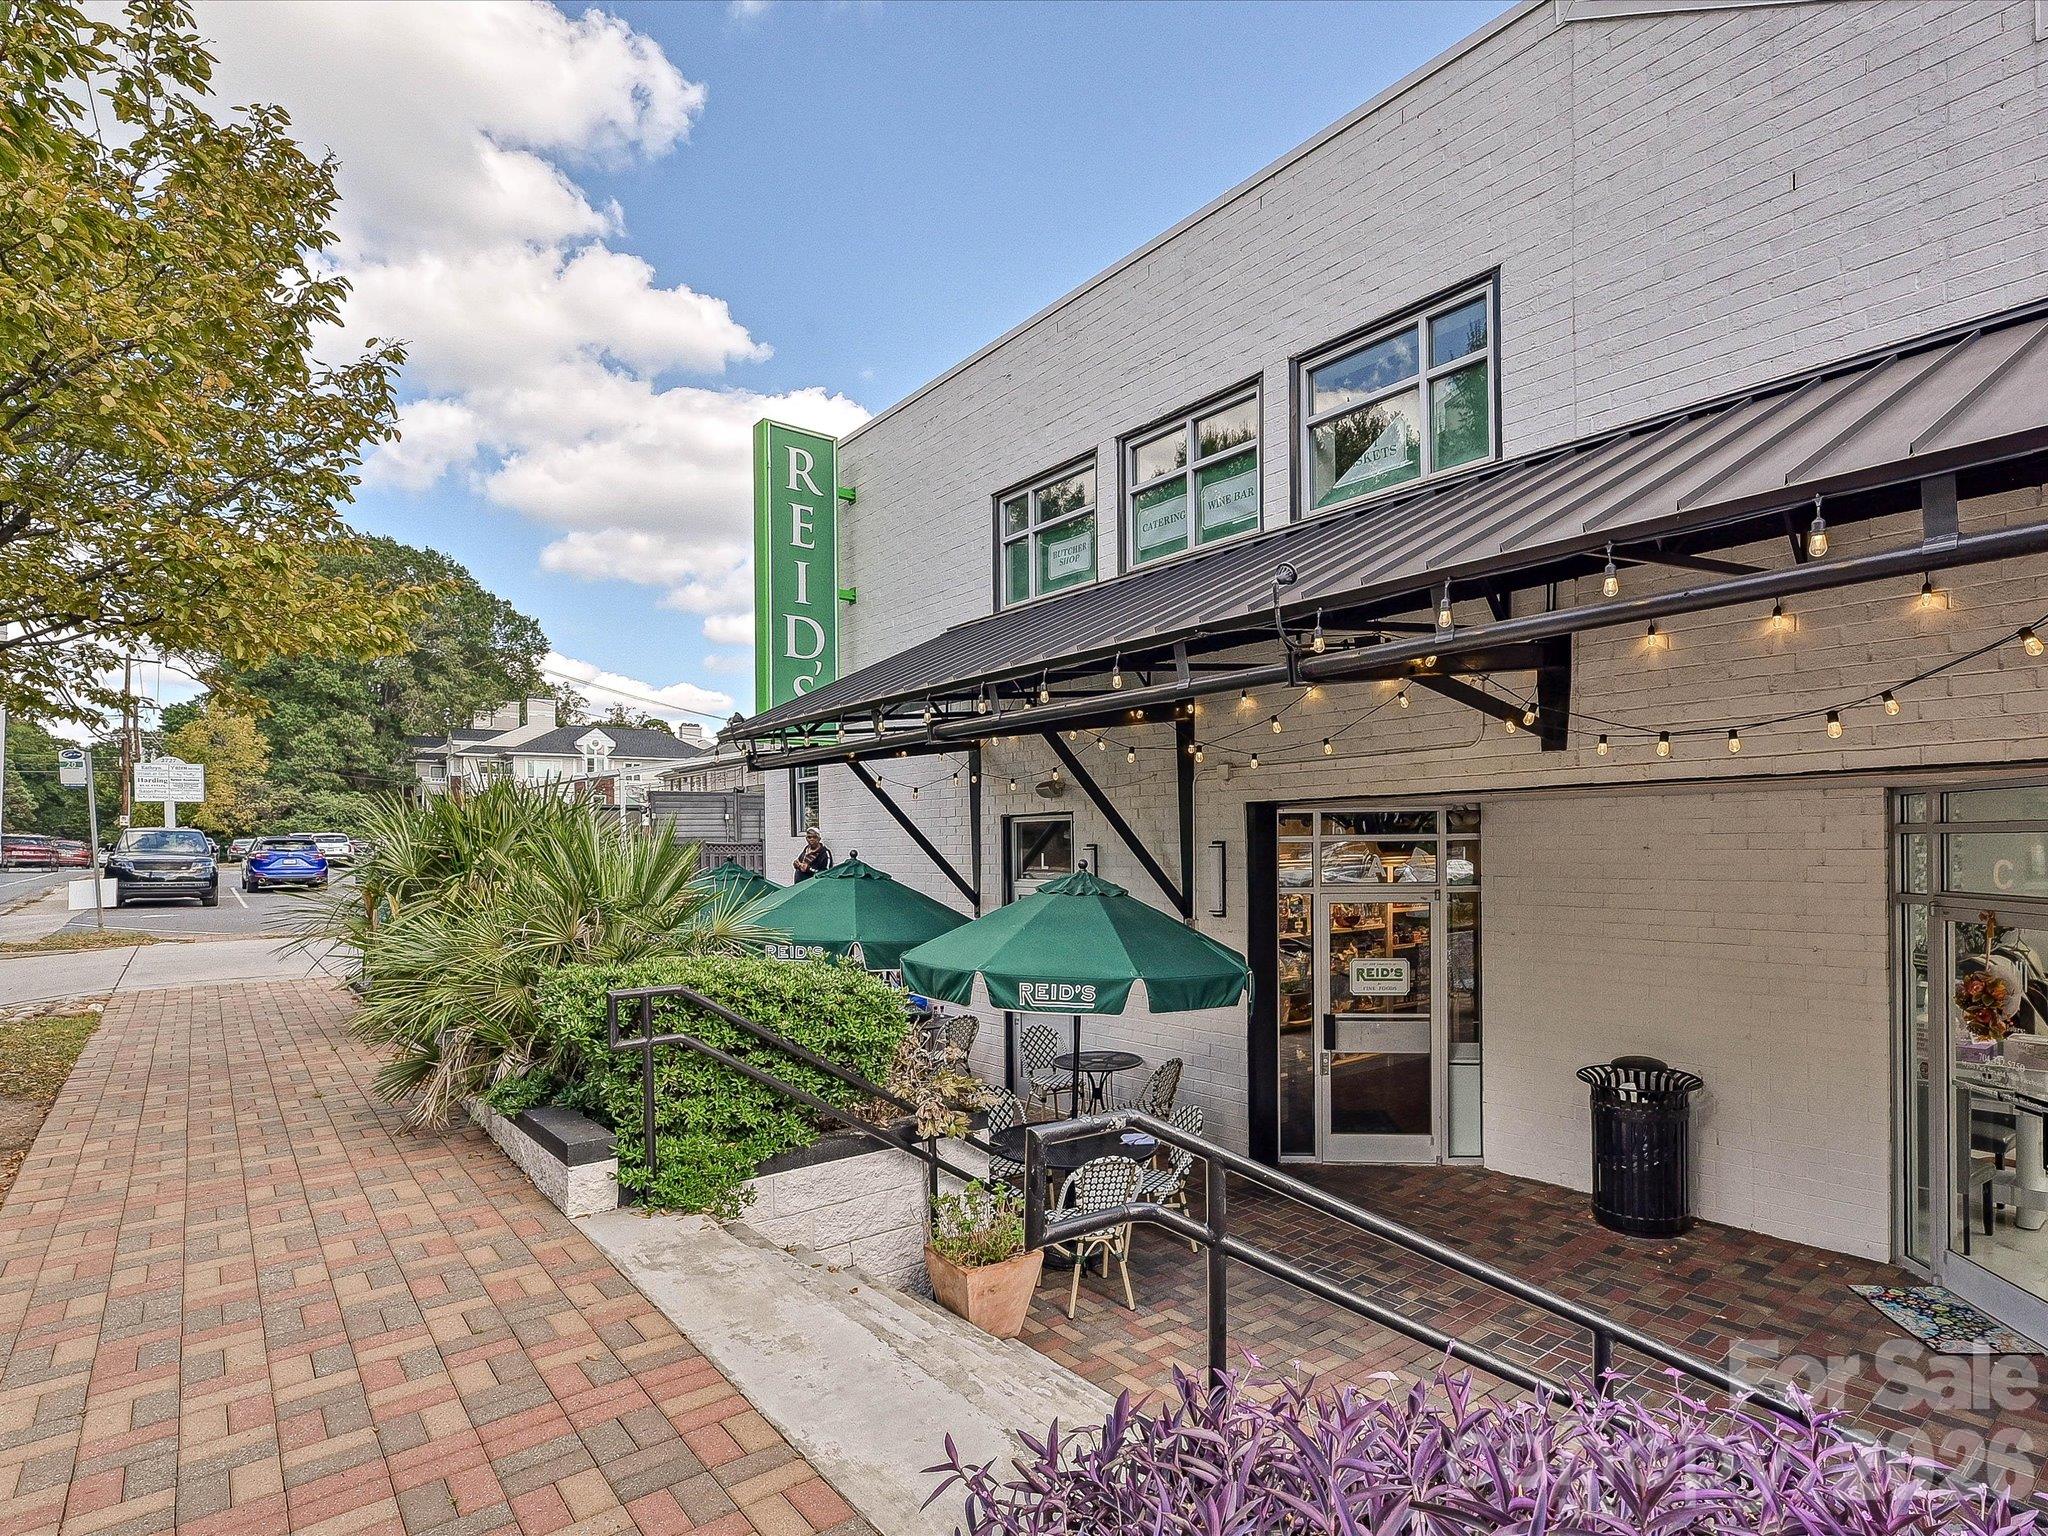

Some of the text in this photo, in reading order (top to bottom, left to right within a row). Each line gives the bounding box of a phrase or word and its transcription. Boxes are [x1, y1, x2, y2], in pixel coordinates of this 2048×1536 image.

[1207, 487, 1255, 510] WINE BAR
[1142, 510, 1186, 532] CATERING
[1053, 542, 1087, 559] BUTCHER
[1059, 554, 1080, 566] SHOP
[1356, 967, 1404, 981] REID'S
[1019, 982, 1097, 1008] REID'S
